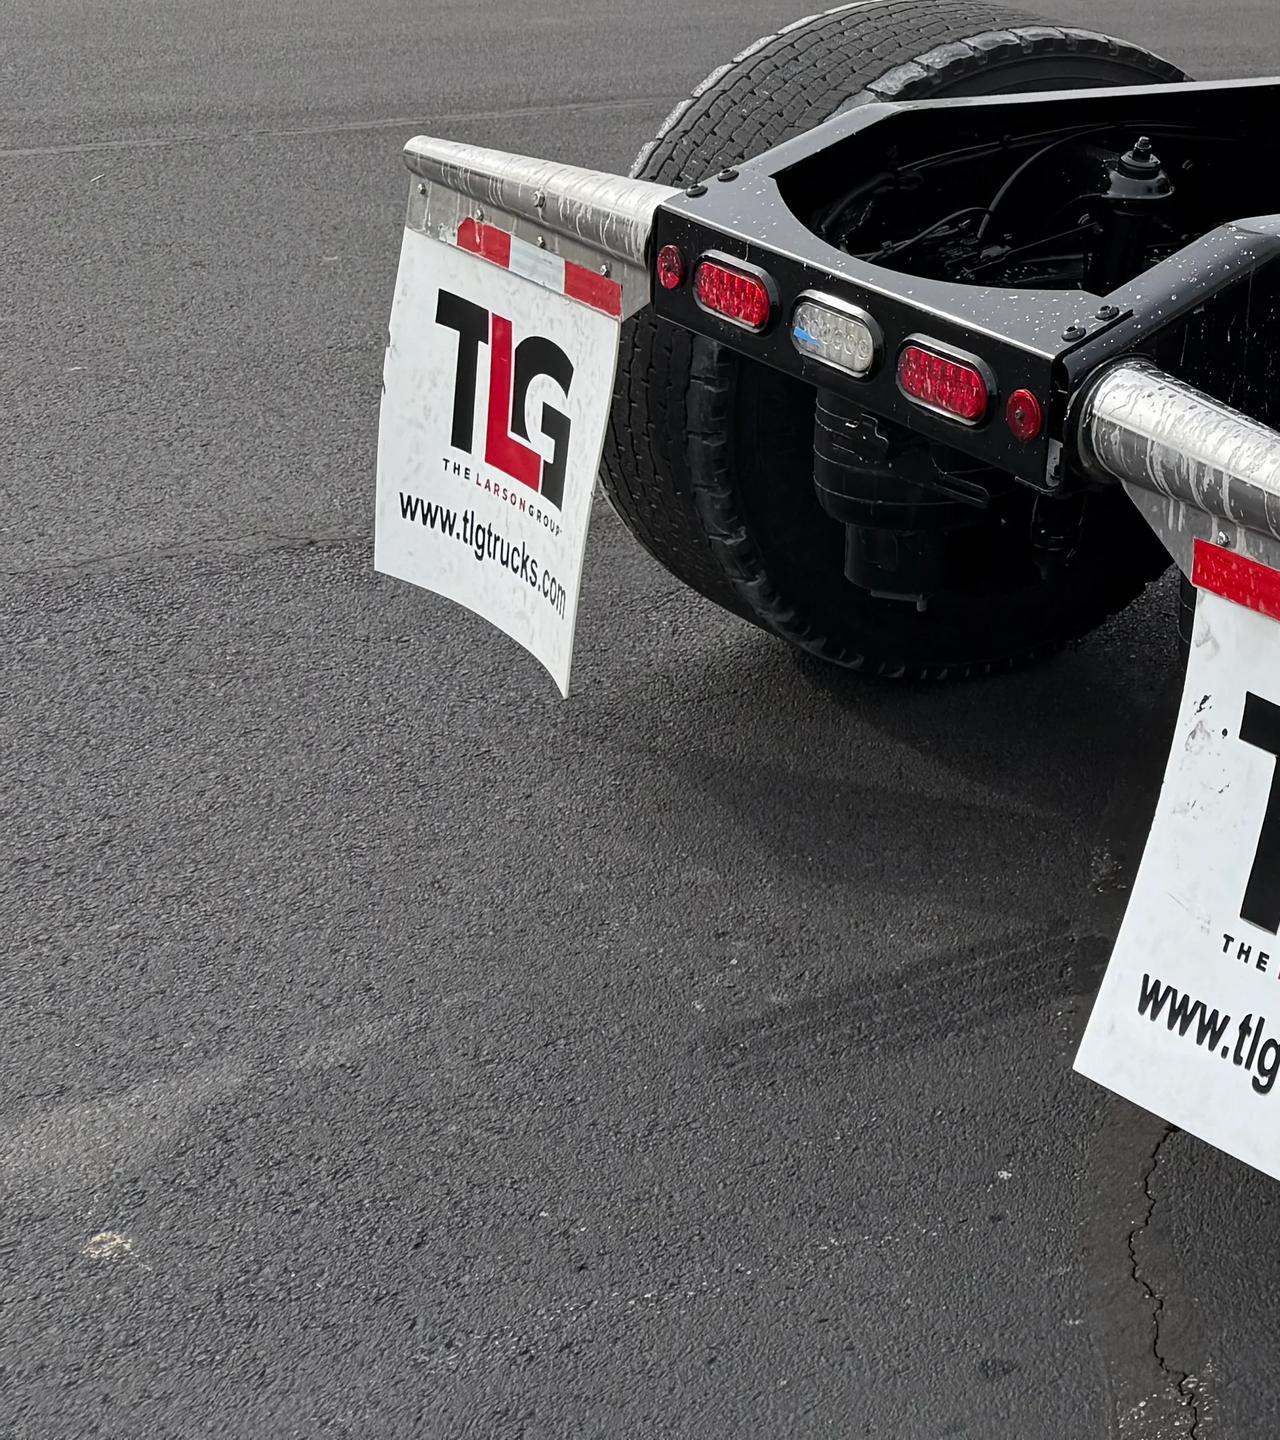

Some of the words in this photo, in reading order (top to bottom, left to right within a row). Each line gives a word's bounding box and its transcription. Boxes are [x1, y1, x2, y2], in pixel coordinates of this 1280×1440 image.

[435, 288, 574, 512] TLG
[442, 458, 471, 480] THE
[476, 473, 526, 511] LARSON
[528, 505, 560, 537] GROUP
[399, 492, 566, 618] www.tlgtrucks.com
[1223, 934, 1270, 972] THE
